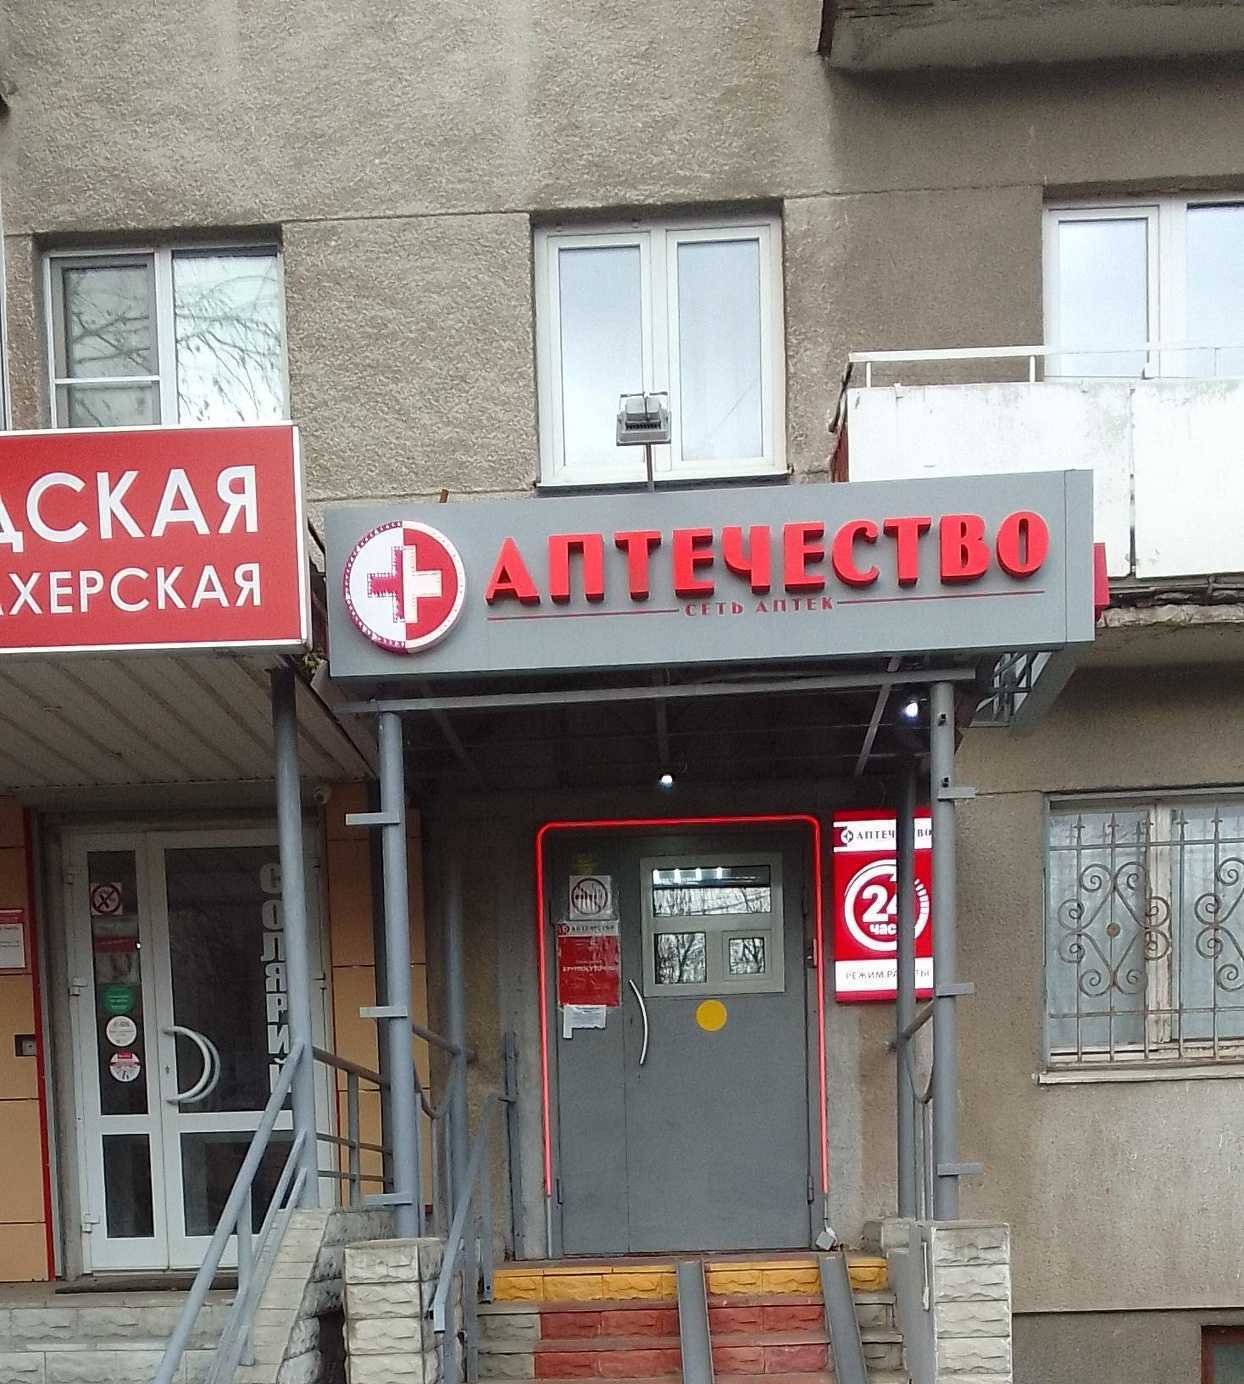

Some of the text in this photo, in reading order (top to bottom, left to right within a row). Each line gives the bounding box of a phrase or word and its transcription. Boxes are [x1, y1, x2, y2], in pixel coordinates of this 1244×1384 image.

[485, 510, 1050, 605] АПТЕЧЕСТВО
[0, 562, 261, 616] ХЕРСКАЯ
[685, 596, 833, 617] СЕТЬ АПТЕК
[855, 829, 932, 840] АПТЕЧВО
